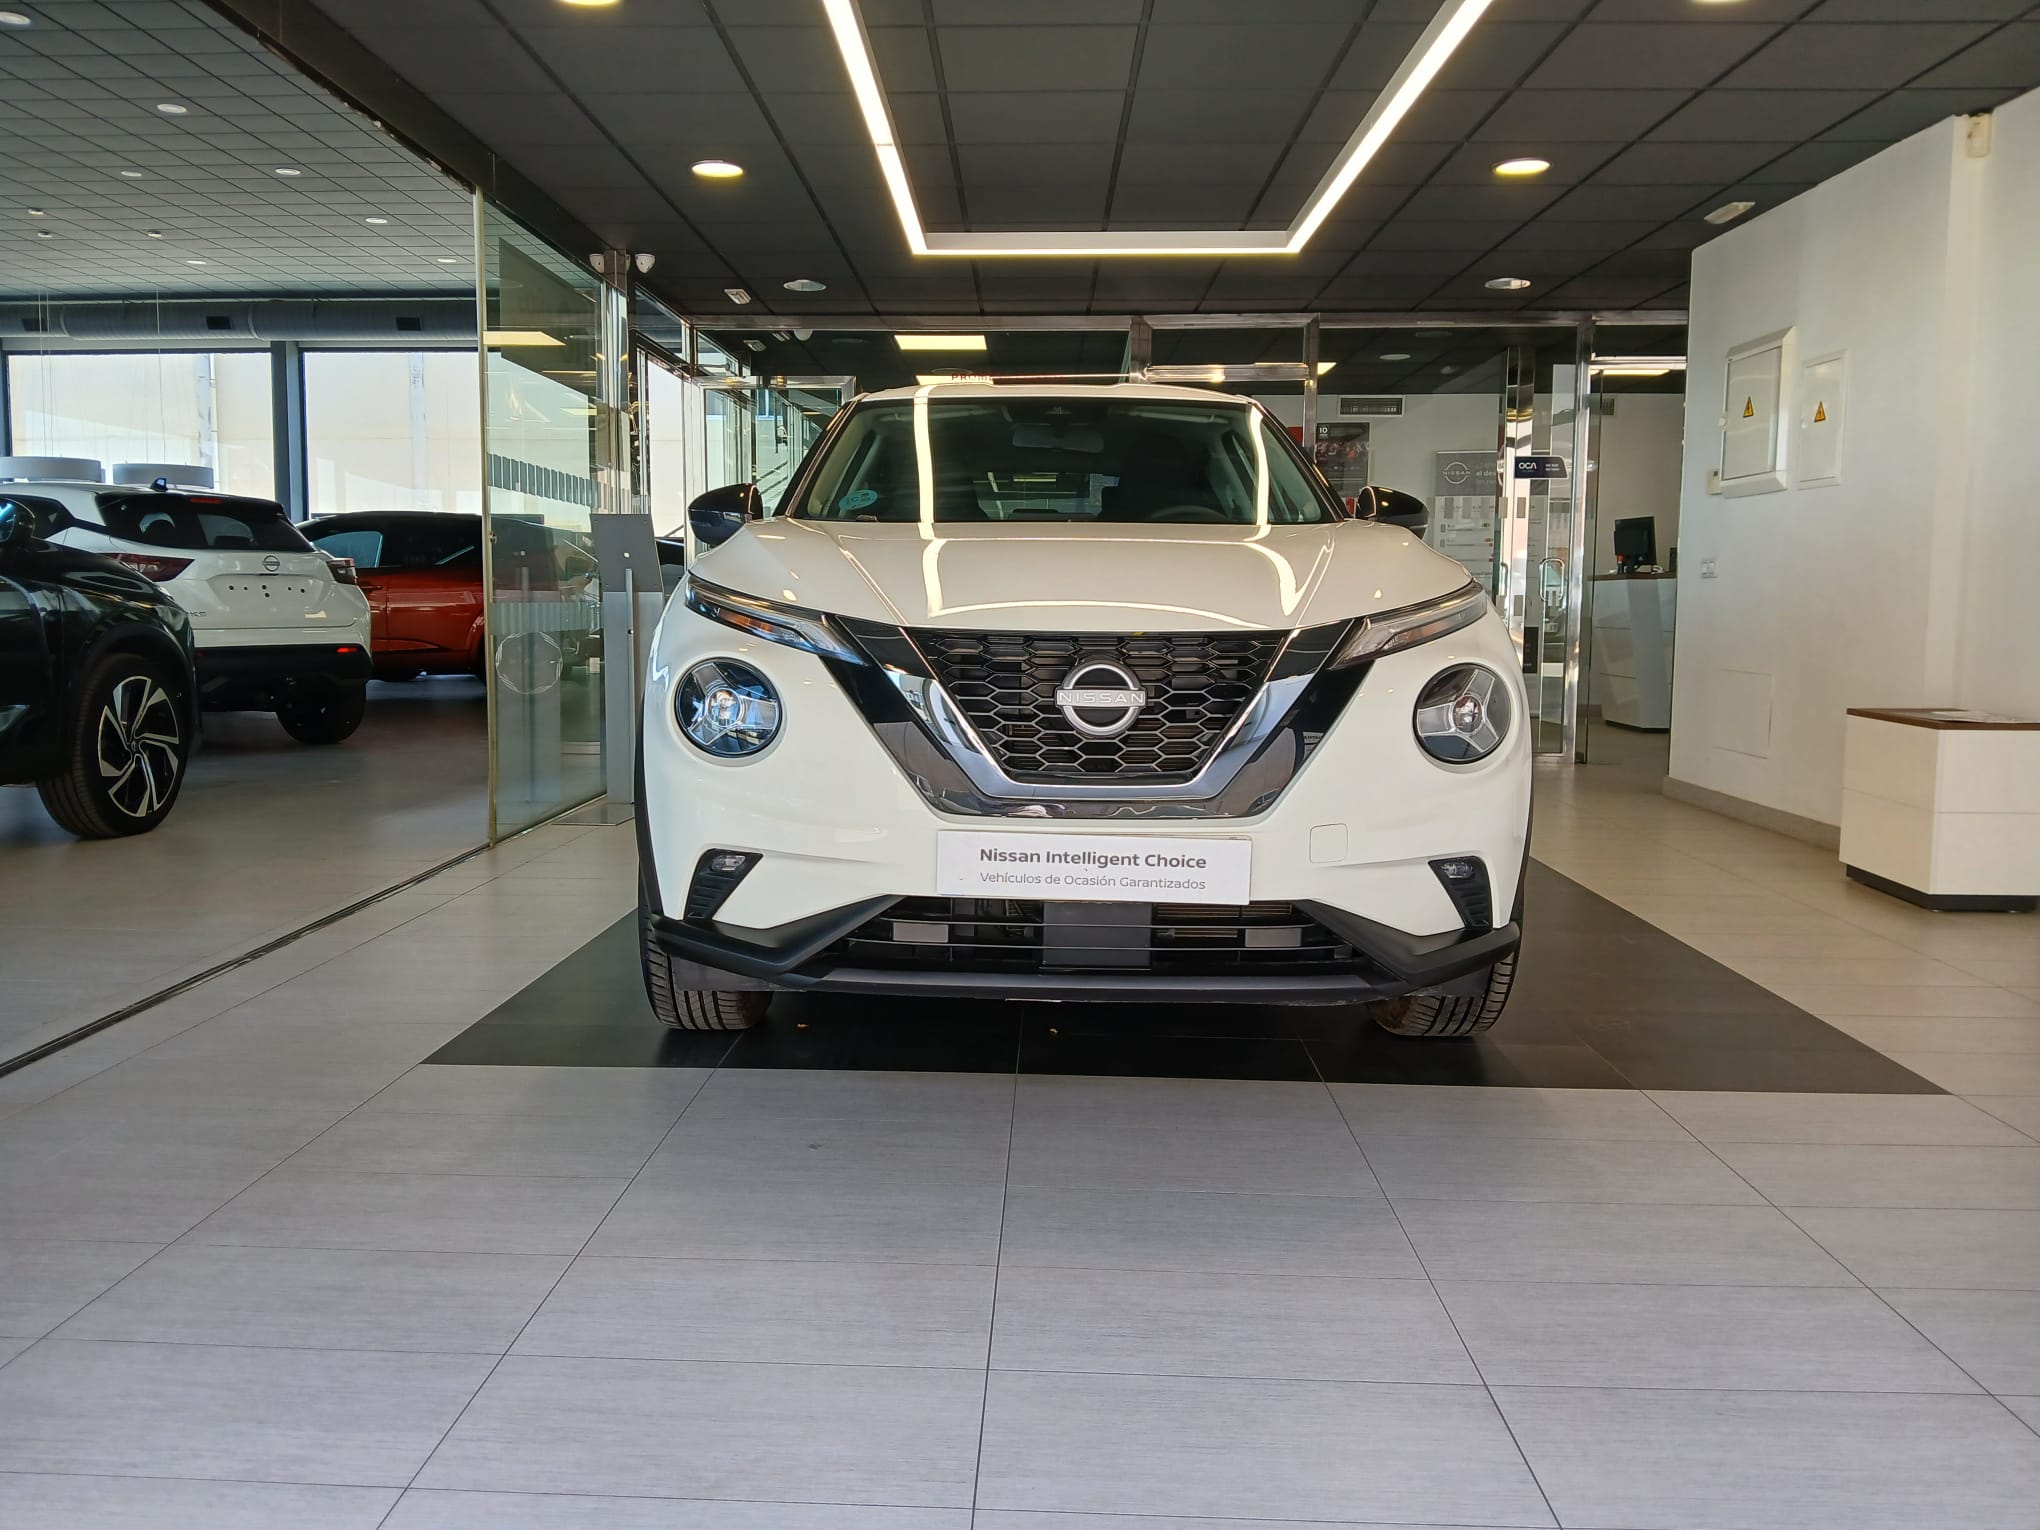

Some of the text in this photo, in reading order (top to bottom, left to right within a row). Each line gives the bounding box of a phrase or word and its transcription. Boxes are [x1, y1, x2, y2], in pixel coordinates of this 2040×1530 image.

[1518, 462, 1537, 470] OCA
[1059, 692, 1144, 704] NISSAN
[980, 848, 1207, 869] Nissan Intelligent Choice
[979, 872, 1206, 890] Vehículos de Ocasión Garantizados
